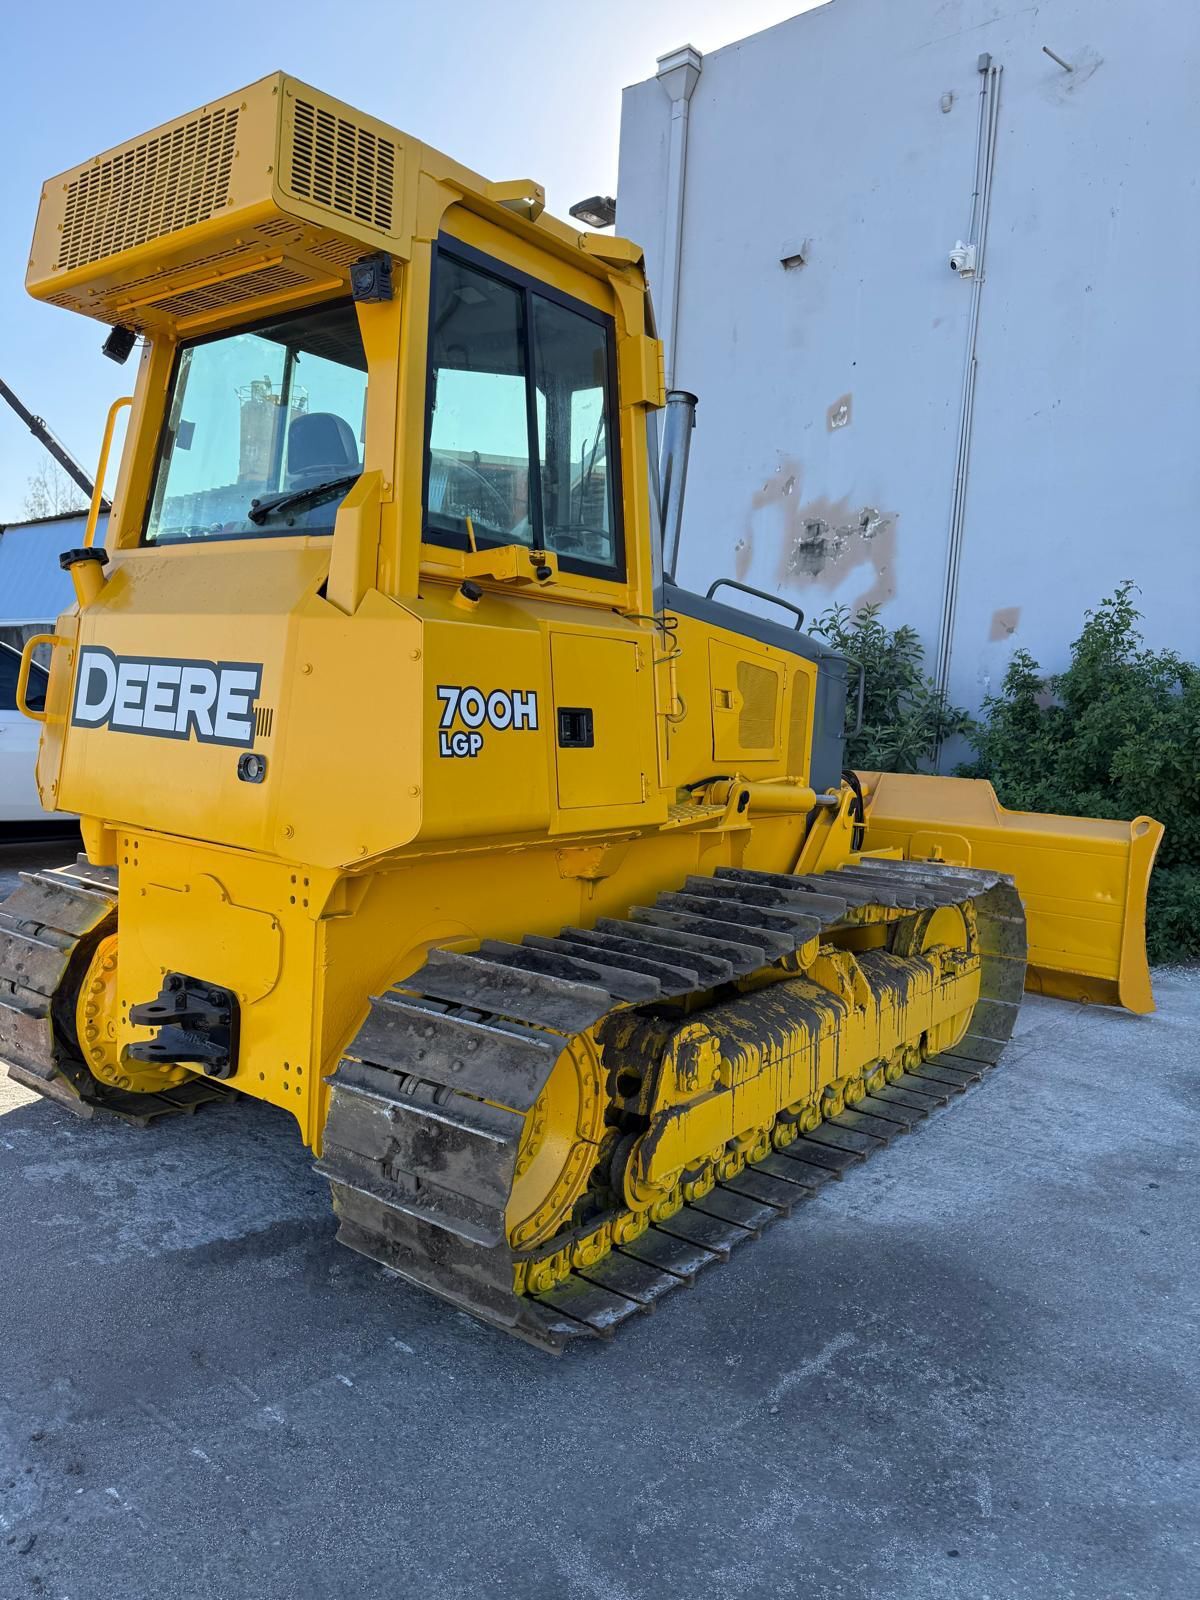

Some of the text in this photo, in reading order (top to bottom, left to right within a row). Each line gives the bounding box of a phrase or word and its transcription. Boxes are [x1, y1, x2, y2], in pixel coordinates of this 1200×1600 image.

[74, 651, 259, 742] DEERE
[437, 686, 538, 730] 700H
[440, 731, 483, 757] LGP
